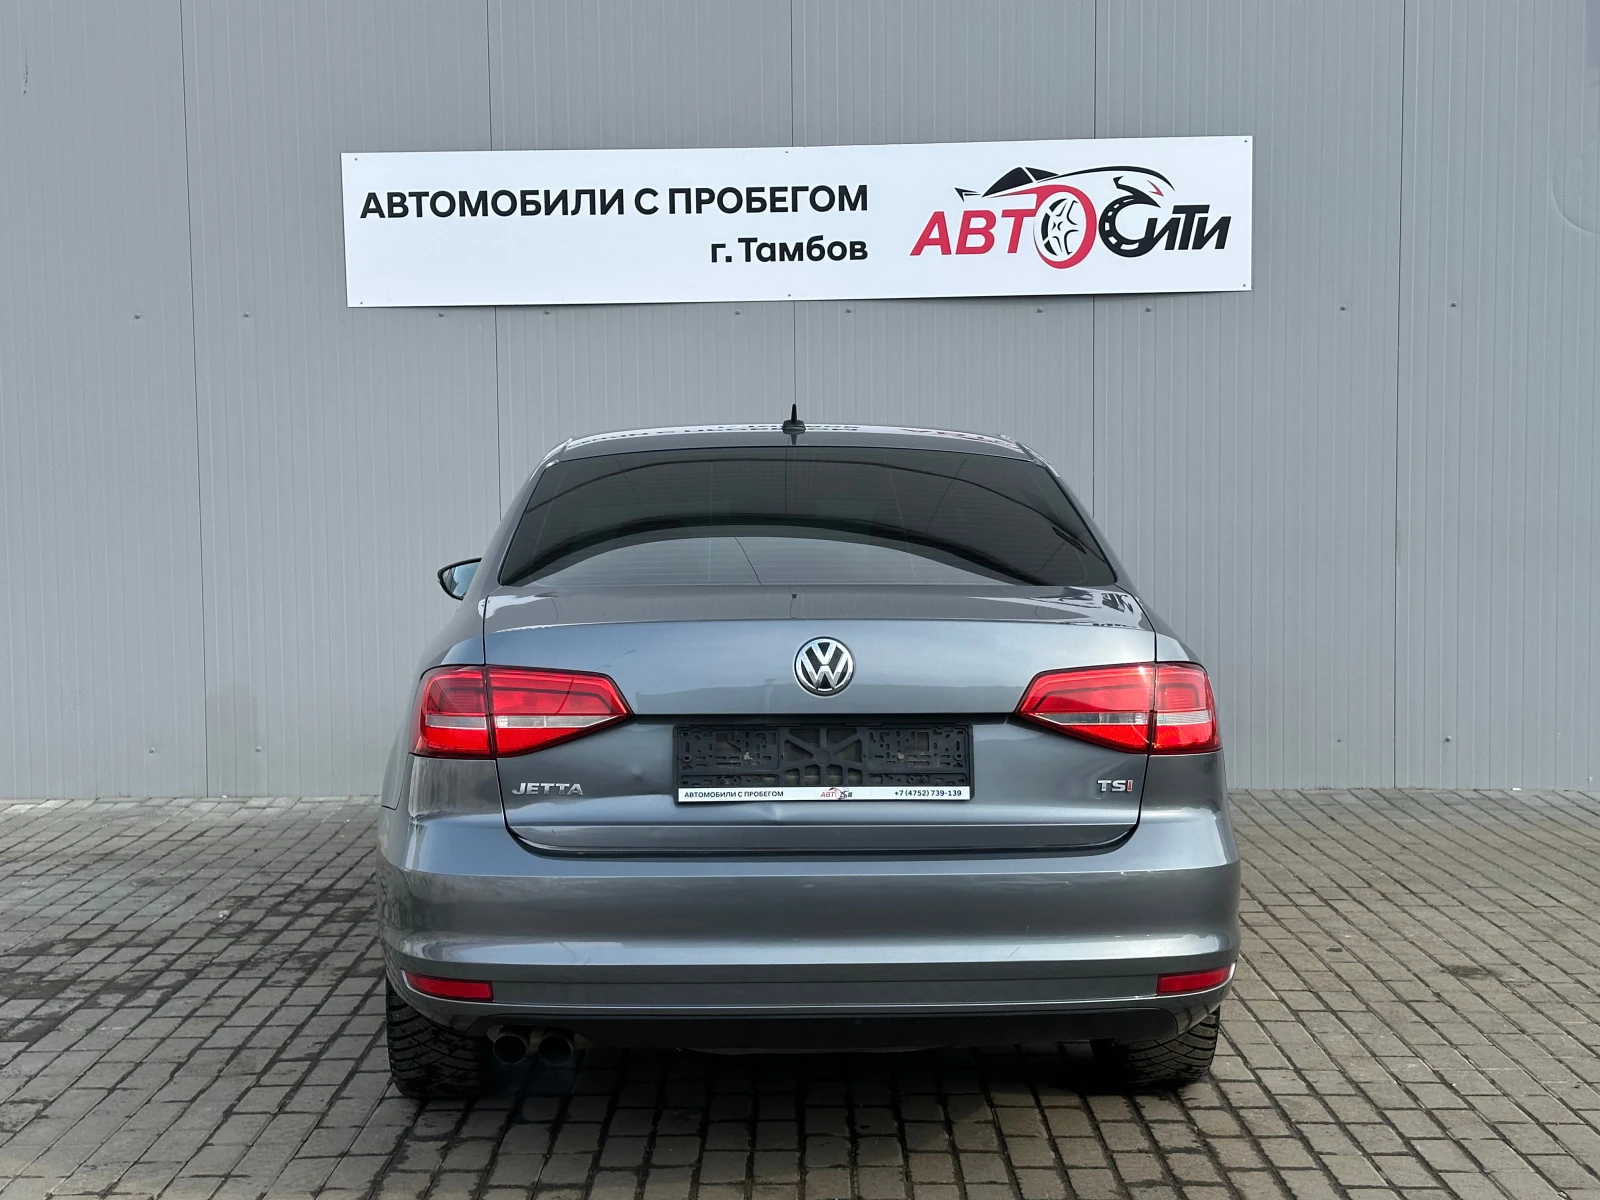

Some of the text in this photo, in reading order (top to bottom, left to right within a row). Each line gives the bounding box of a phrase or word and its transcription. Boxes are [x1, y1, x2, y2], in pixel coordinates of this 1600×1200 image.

[360, 184, 869, 219] АВТОМОБИЛИ С ПРОБЕГОМ
[711, 235, 869, 263] г. Тамбов
[511, 782, 584, 796] JETTA
[1097, 779, 1134, 793] TSI
[894, 789, 962, 798] +7 (4752) 739-139
